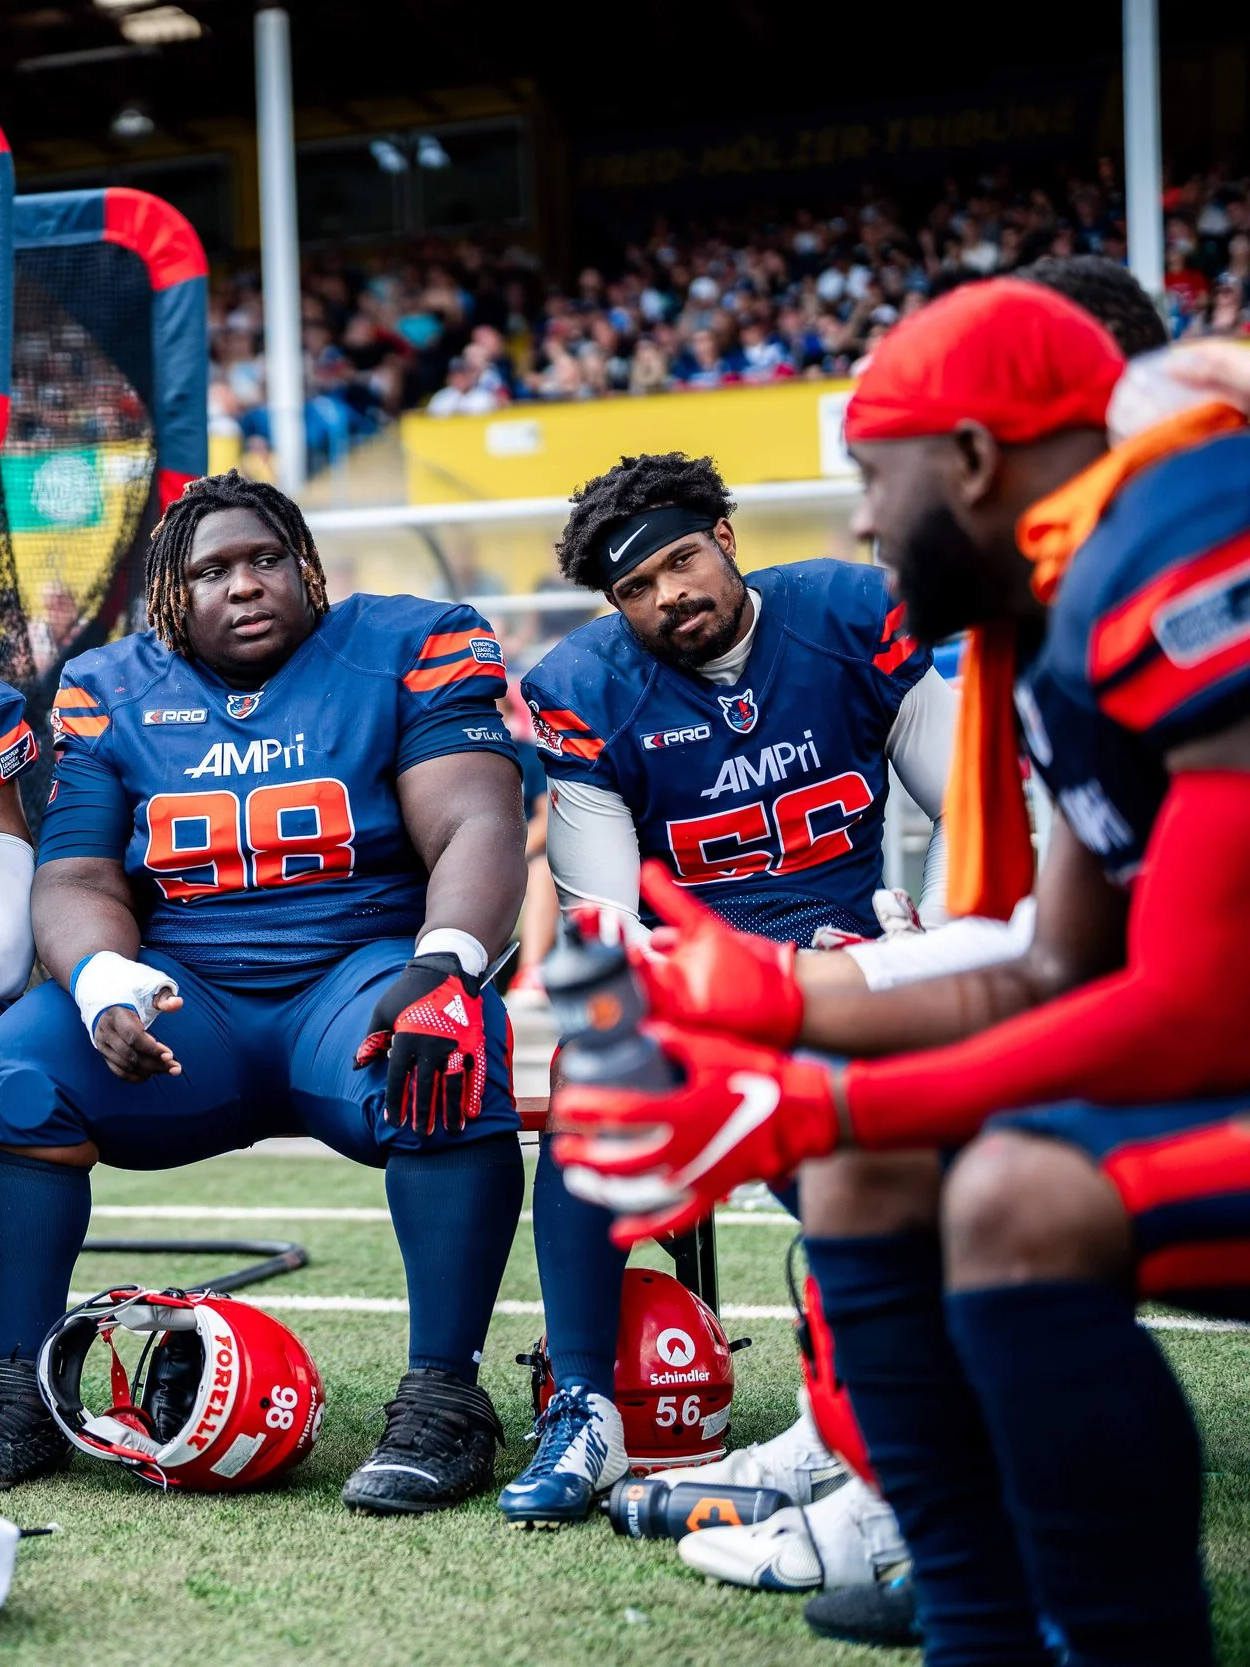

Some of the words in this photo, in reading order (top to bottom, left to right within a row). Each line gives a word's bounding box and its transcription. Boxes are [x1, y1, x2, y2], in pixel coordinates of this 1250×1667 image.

[182, 732, 305, 779] AMPri
[700, 729, 822, 800] AMPri
[143, 777, 356, 903] 98
[187, 1334, 233, 1452] FORELLE
[650, 1368, 711, 1386] Schindler
[655, 1394, 701, 1427] 56
